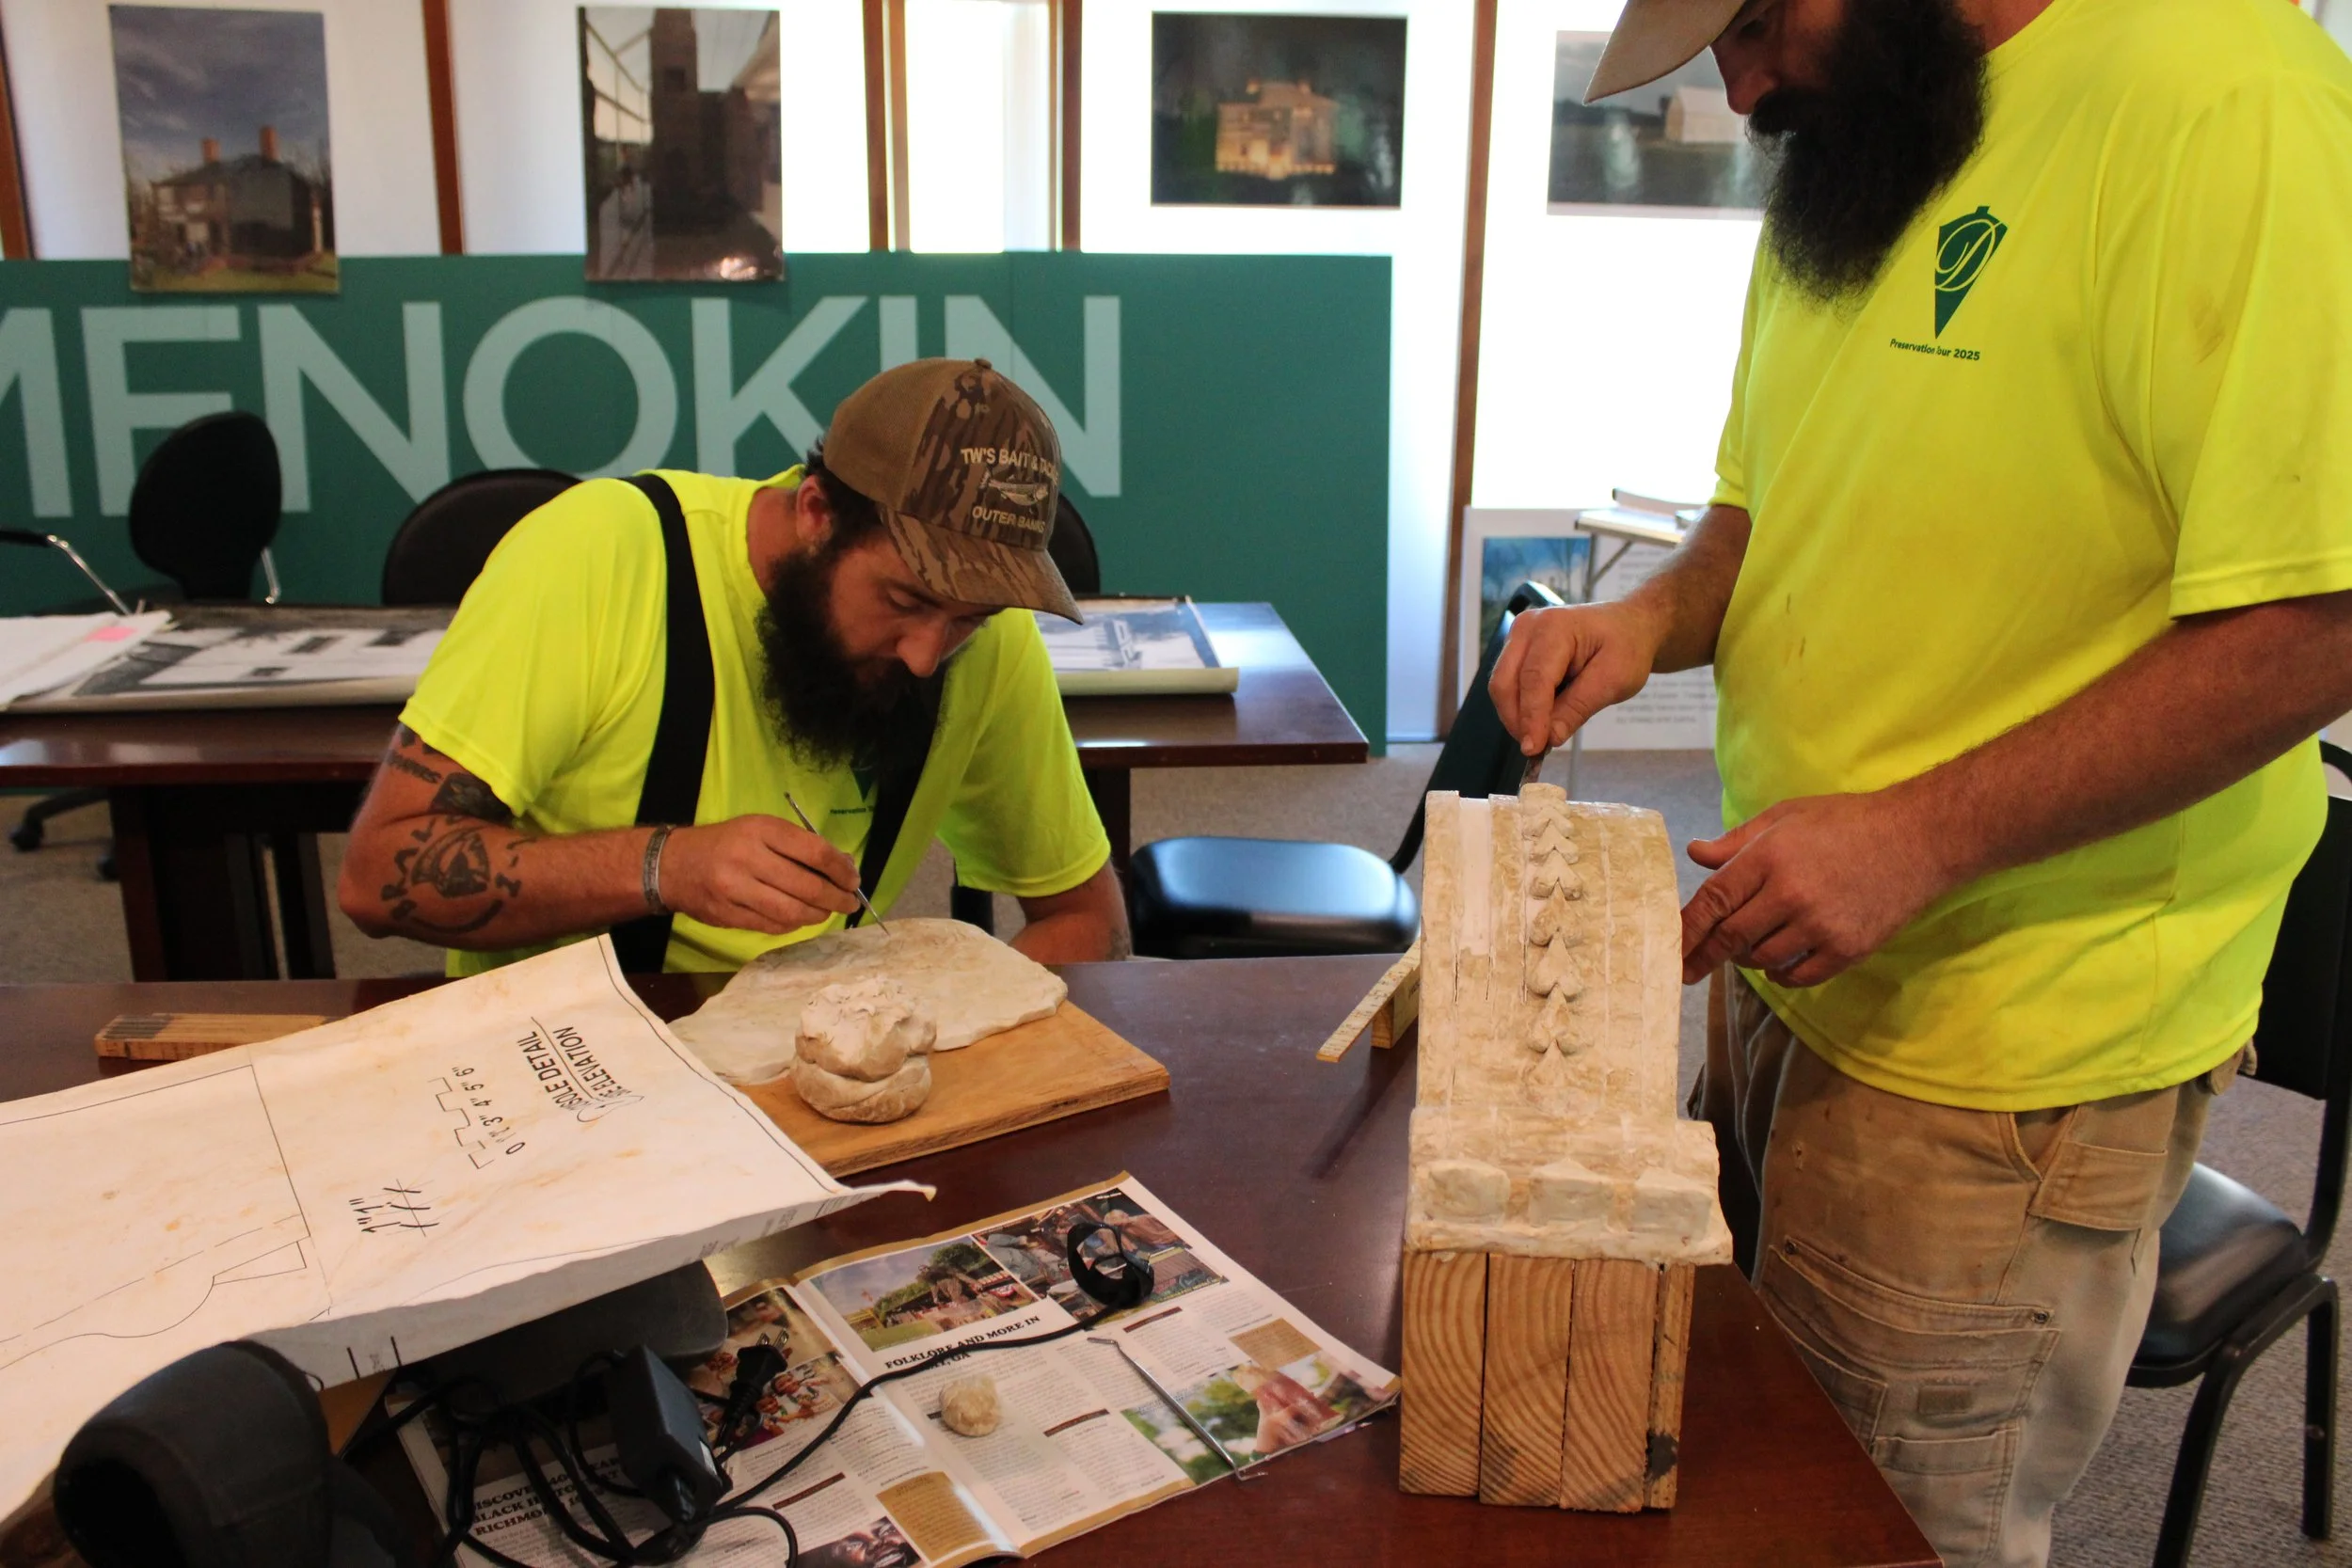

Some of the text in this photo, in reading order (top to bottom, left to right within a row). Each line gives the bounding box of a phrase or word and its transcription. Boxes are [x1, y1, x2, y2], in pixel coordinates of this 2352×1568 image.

[1890, 338, 1935, 355] Preservation
[1953, 348, 1981, 361] 2025
[961, 447, 996, 465] TW'S
[998, 449, 1030, 467] BAIT
[1030, 454, 1039, 470] &
[972, 505, 1016, 526] OUTER
[516, 1030, 563, 1082] DETAIL
[552, 1026, 617, 1092] ELEVATION
[452, 1066, 475, 1078] 6"
[460, 1081, 485, 1092] 5"
[469, 1097, 493, 1107] 4"
[478, 1114, 503, 1127] 3"
[505, 1141, 526, 1155] 0
[884, 1344, 954, 1370] FOLKLORE
[957, 1334, 986, 1348] AND
[986, 1322, 1025, 1340] MORE
[1025, 1314, 1041, 1327] IN
